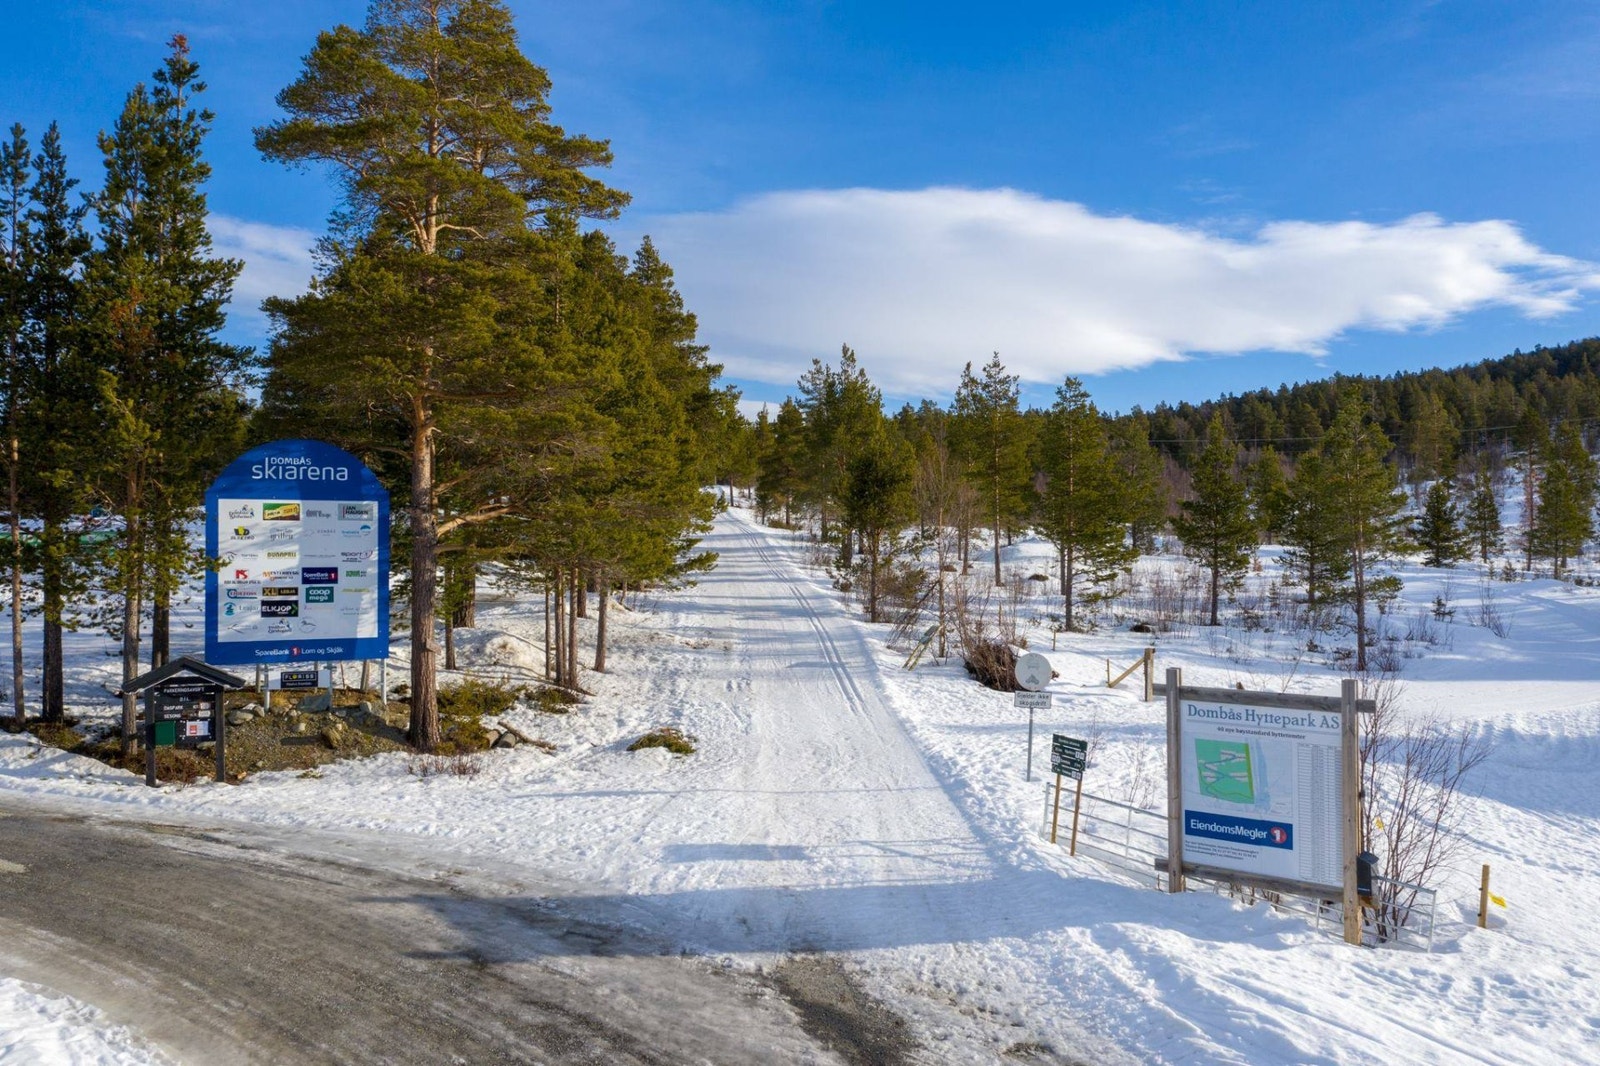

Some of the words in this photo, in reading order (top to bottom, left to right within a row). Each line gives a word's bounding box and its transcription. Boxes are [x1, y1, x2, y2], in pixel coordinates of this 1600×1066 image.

[252, 458, 348, 480] skiarena
[271, 456, 312, 466] DOMBÅS
[1188, 704, 1242, 720] Dombås
[1245, 709, 1316, 728] Hyttepark
[1320, 715, 1340, 729] AS
[1190, 819, 1267, 839] EiendomsMegler
[1274, 830, 1281, 841] 1
